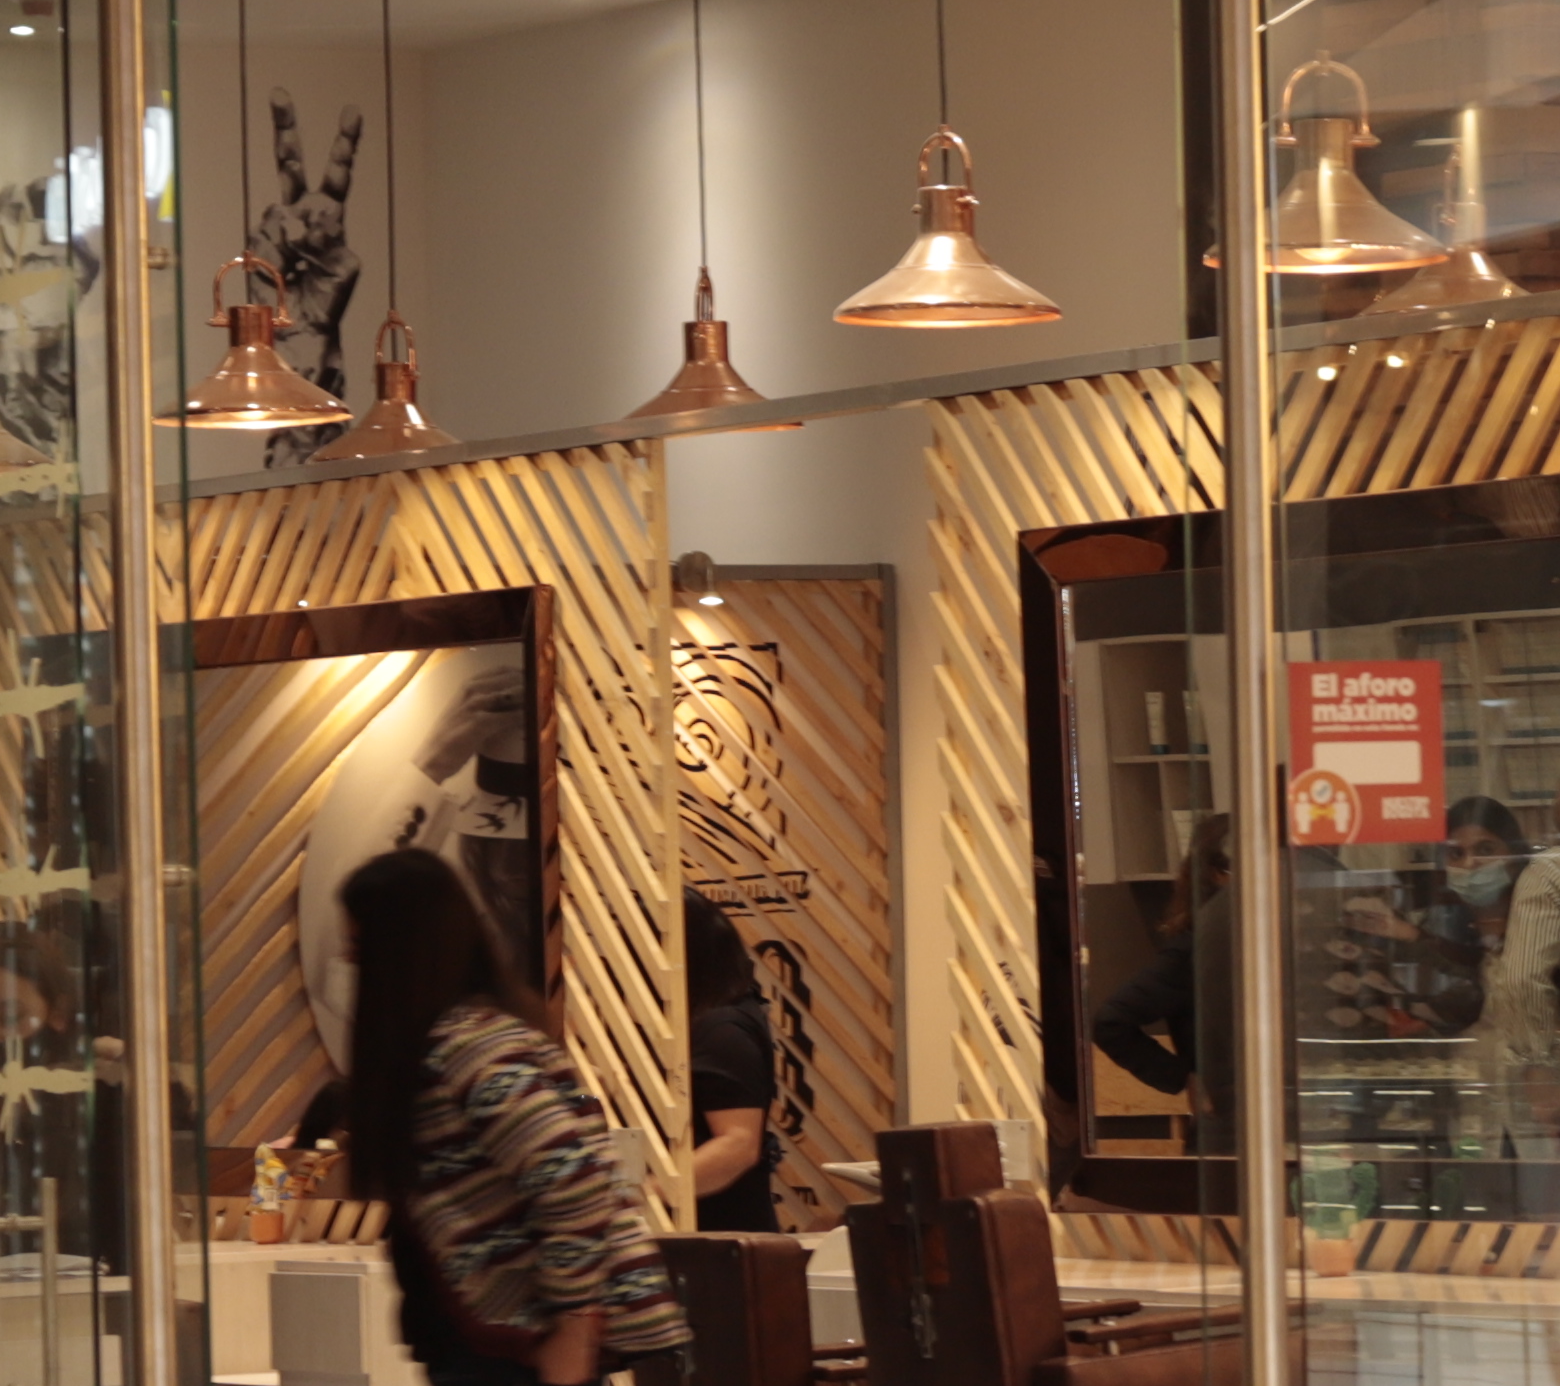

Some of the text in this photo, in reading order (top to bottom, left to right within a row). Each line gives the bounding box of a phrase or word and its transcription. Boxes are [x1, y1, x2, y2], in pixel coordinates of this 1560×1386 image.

[1310, 672, 1416, 698] El aforo
[1311, 698, 1419, 723] máximo
